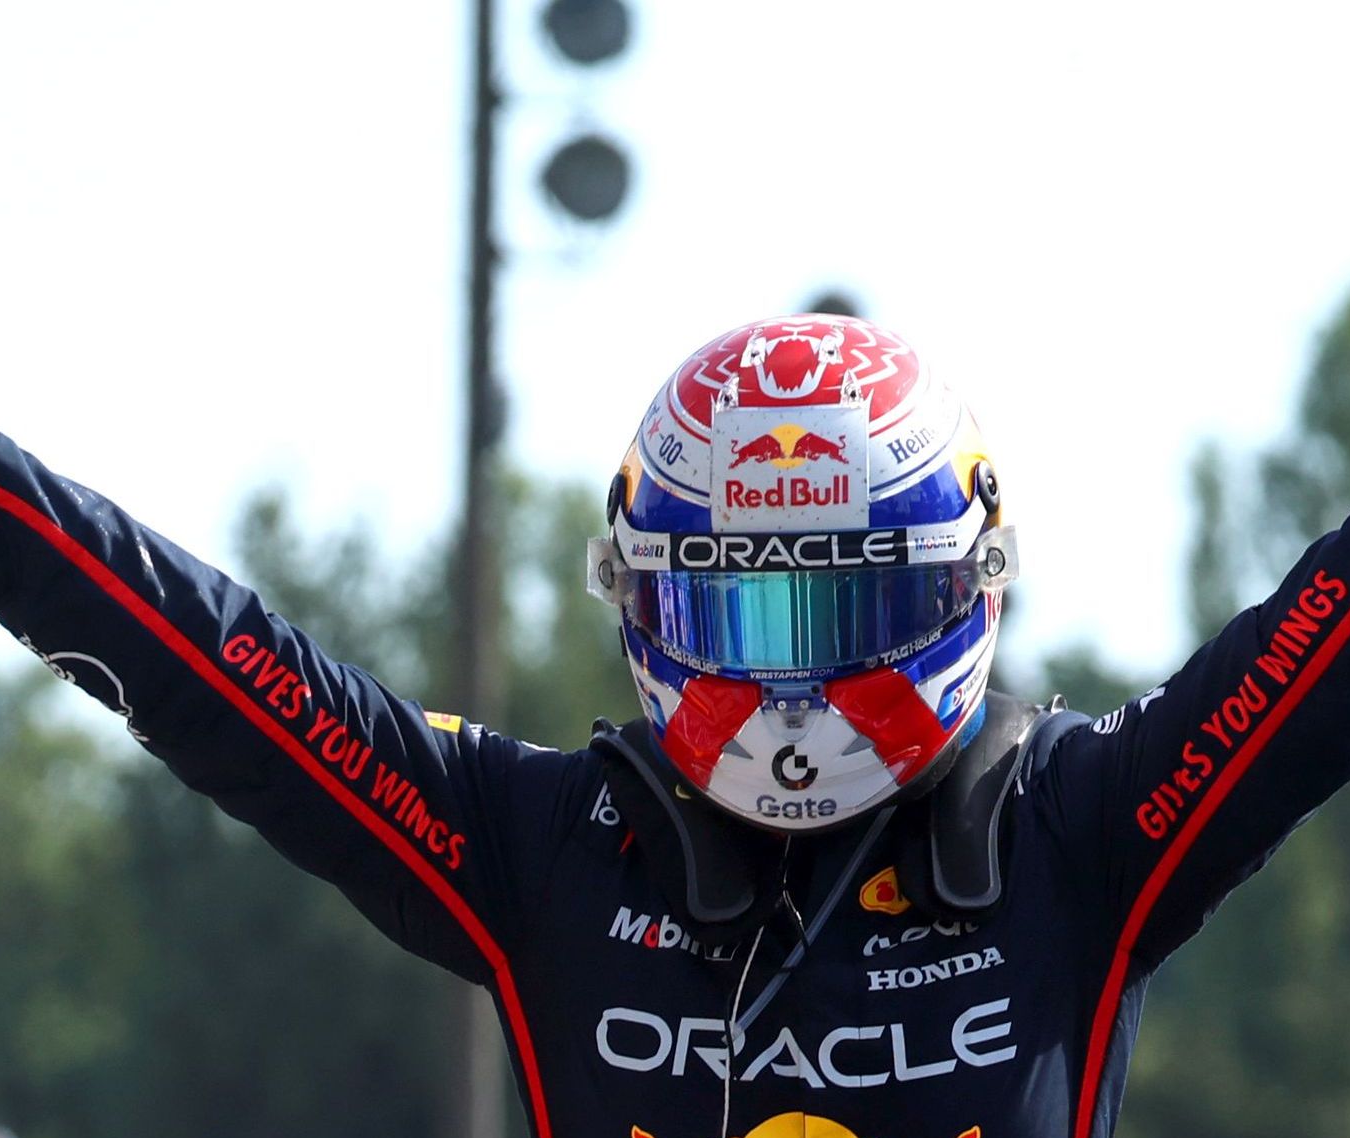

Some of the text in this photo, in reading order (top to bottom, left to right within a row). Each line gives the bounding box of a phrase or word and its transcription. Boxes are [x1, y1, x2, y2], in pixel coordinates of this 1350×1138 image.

[725, 474, 849, 508] Red Bull
[678, 531, 895, 568] ORACLE
[1201, 673, 1268, 751] YOU
[1255, 569, 1348, 686] WINGS
[221, 634, 467, 871] GIVES YOU WINGS
[756, 794, 838, 820] Gate
[866, 946, 1005, 991] HONDA
[596, 997, 1018, 1089] ORACLE
